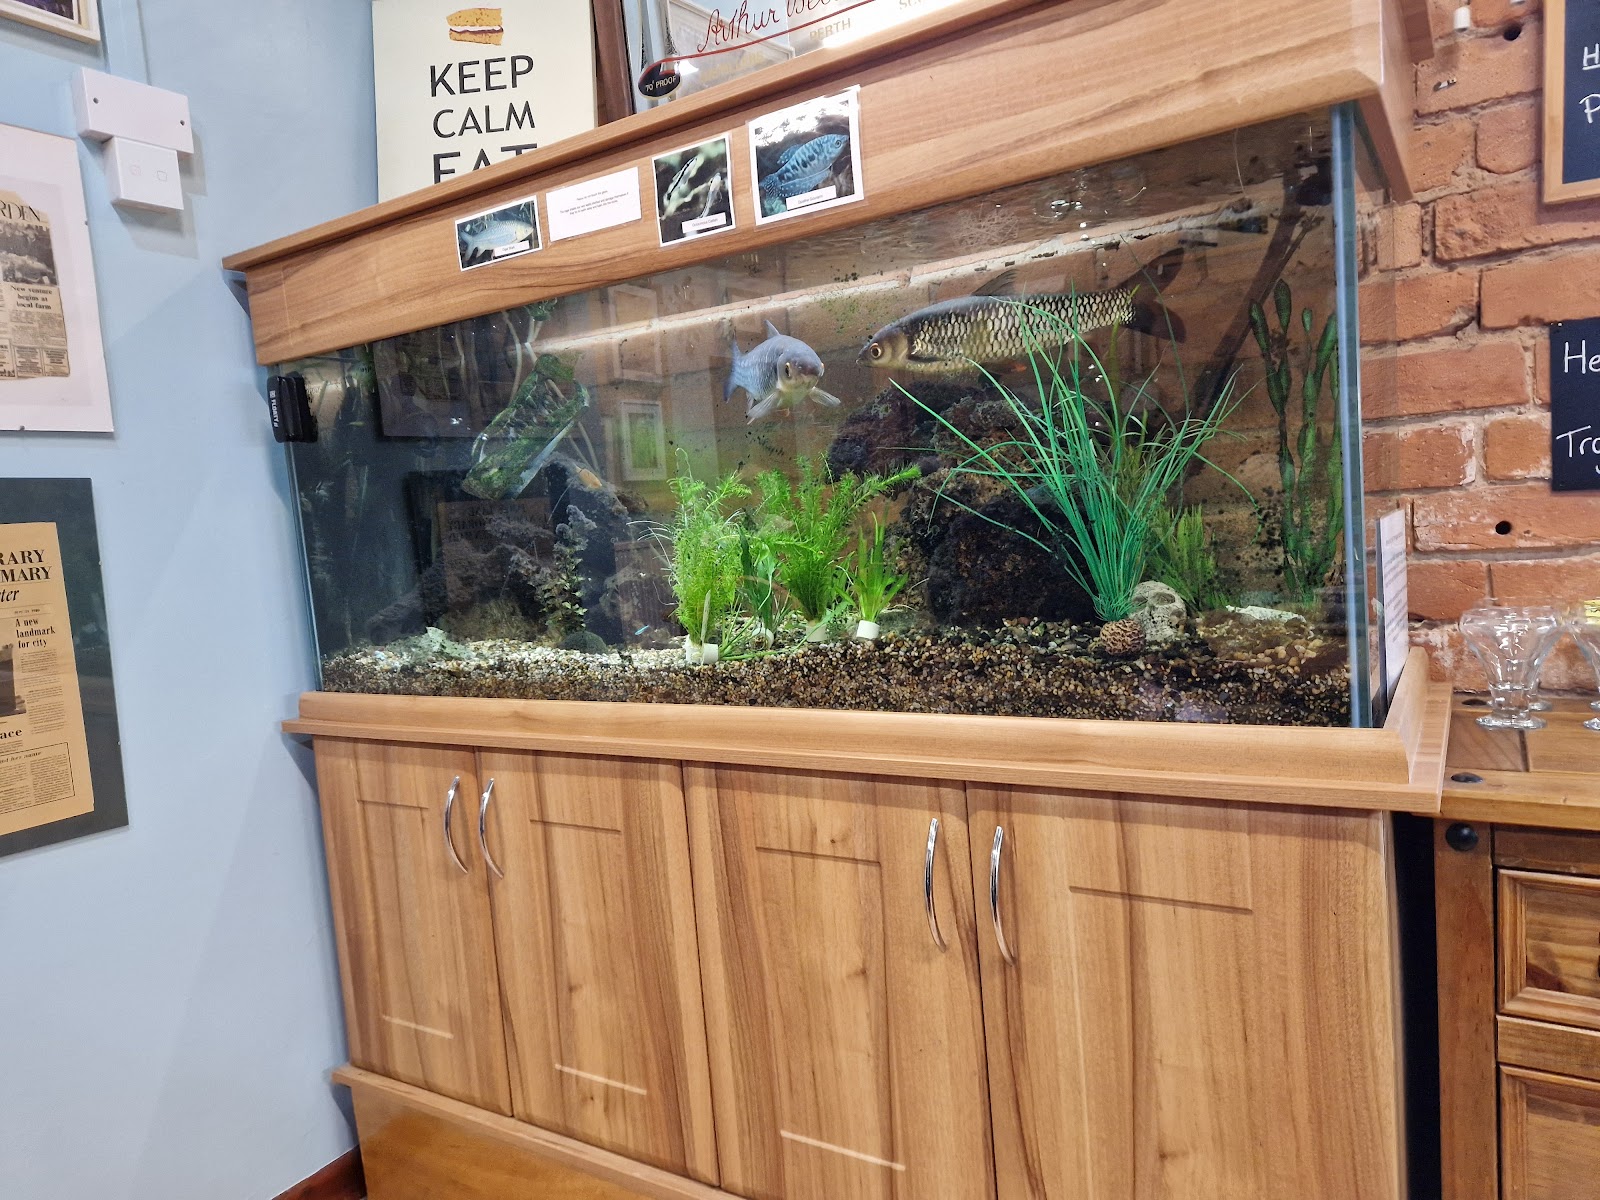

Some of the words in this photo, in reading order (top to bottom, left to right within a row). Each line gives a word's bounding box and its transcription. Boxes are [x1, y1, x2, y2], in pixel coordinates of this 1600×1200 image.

[697, 0, 780, 52] Arthur
[810, 18, 851, 40] PERTH
[430, 55, 534, 97] KEEP
[655, 76, 677, 89] PROOF
[433, 101, 535, 138] CALM
[17, 294, 39, 302] begins
[0, 566, 52, 582] MARY
[0, 588, 20, 602] ter
[16, 618, 21, 627] A
[23, 619, 39, 627] new
[16, 626, 56, 638] landmark
[18, 640, 30, 648] for
[32, 638, 47, 648] city
